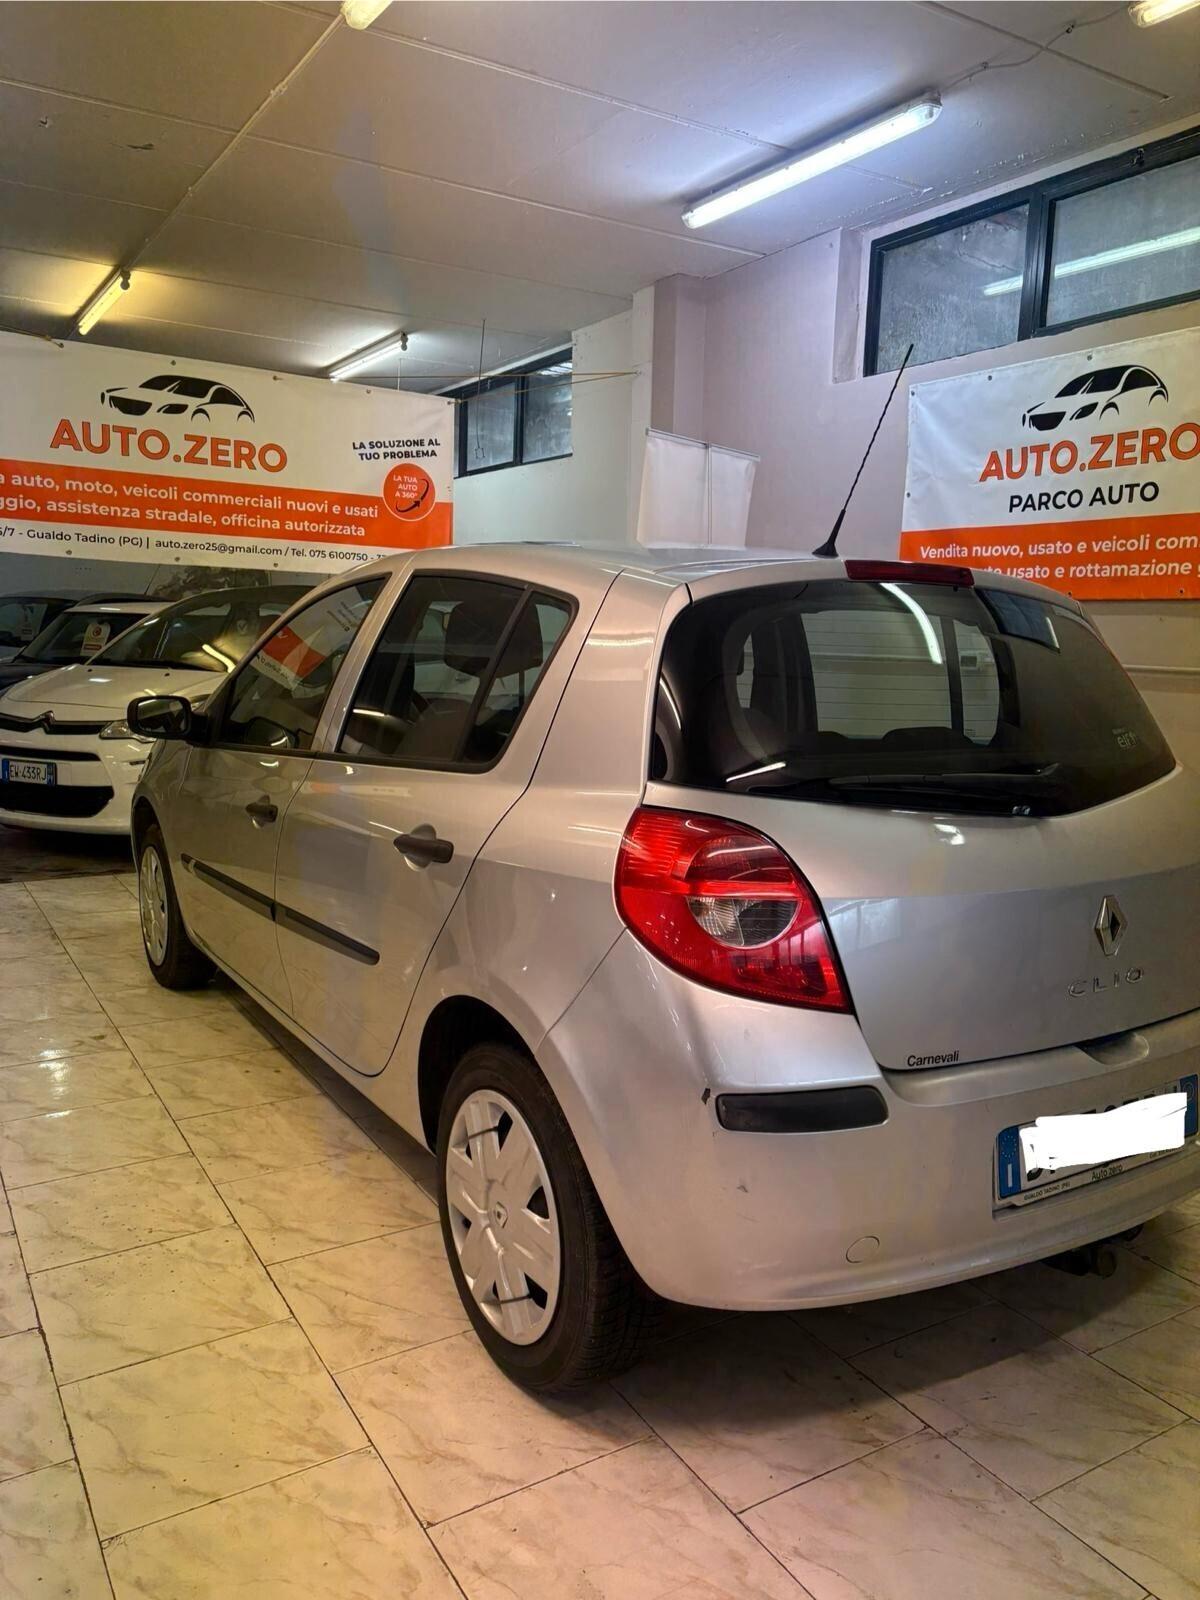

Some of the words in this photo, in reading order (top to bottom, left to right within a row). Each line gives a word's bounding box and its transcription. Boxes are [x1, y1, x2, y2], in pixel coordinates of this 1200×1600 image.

[50, 418, 288, 473] AUTO.ZERO
[352, 441, 366, 450] LA
[369, 439, 425, 449] SOLUZIONE
[428, 438, 441, 446] AL
[359, 452, 380, 461] TUO
[383, 450, 437, 460] PROBLEMA
[979, 422, 1200, 483] AUTO.ZERO
[393, 474, 402, 482] LA
[403, 475, 418, 483] TUA
[398, 483, 418, 491] AUTO
[11, 474, 60, 492] auto,
[65, 479, 118, 497] moto,
[123, 483, 178, 500] veicoli
[182, 490, 282, 509] commerciali
[287, 500, 328, 513] nuovi
[332, 504, 341, 515] e
[345, 505, 378, 518] usati
[1008, 489, 1083, 513] PARCO
[1089, 481, 1160, 507] AUTO
[46, 499, 140, 519] assistenza
[145, 508, 217, 527] stradale,
[221, 513, 281, 529] officina
[285, 520, 366, 537] autorizzata
[27, 529, 72, 542] Gualdo
[75, 532, 116, 544] Tadino
[118, 535, 143, 549] (PG)
[155, 539, 282, 556] auto.zero25@gmail.com
[291, 548, 307, 558] Tel.
[309, 549, 327, 559] 075
[328, 551, 368, 561] 6100750
[920, 543, 968, 559] Vendita
[972, 545, 1024, 558] nuovo,
[1028, 541, 1073, 556] usato
[1077, 541, 1088, 553] e
[1092, 533, 1151, 553] veicoli
[1155, 535, 1200, 551] com
[1006, 565, 1050, 579] usato
[1054, 566, 1065, 578] e
[1069, 558, 1193, 578] rottamazione
[1067, 967, 1145, 998] CLIO
[907, 1051, 959, 1068] Carnevali
[1091, 1169, 1108, 1181] Auto
[1109, 1164, 1123, 1176] zero
